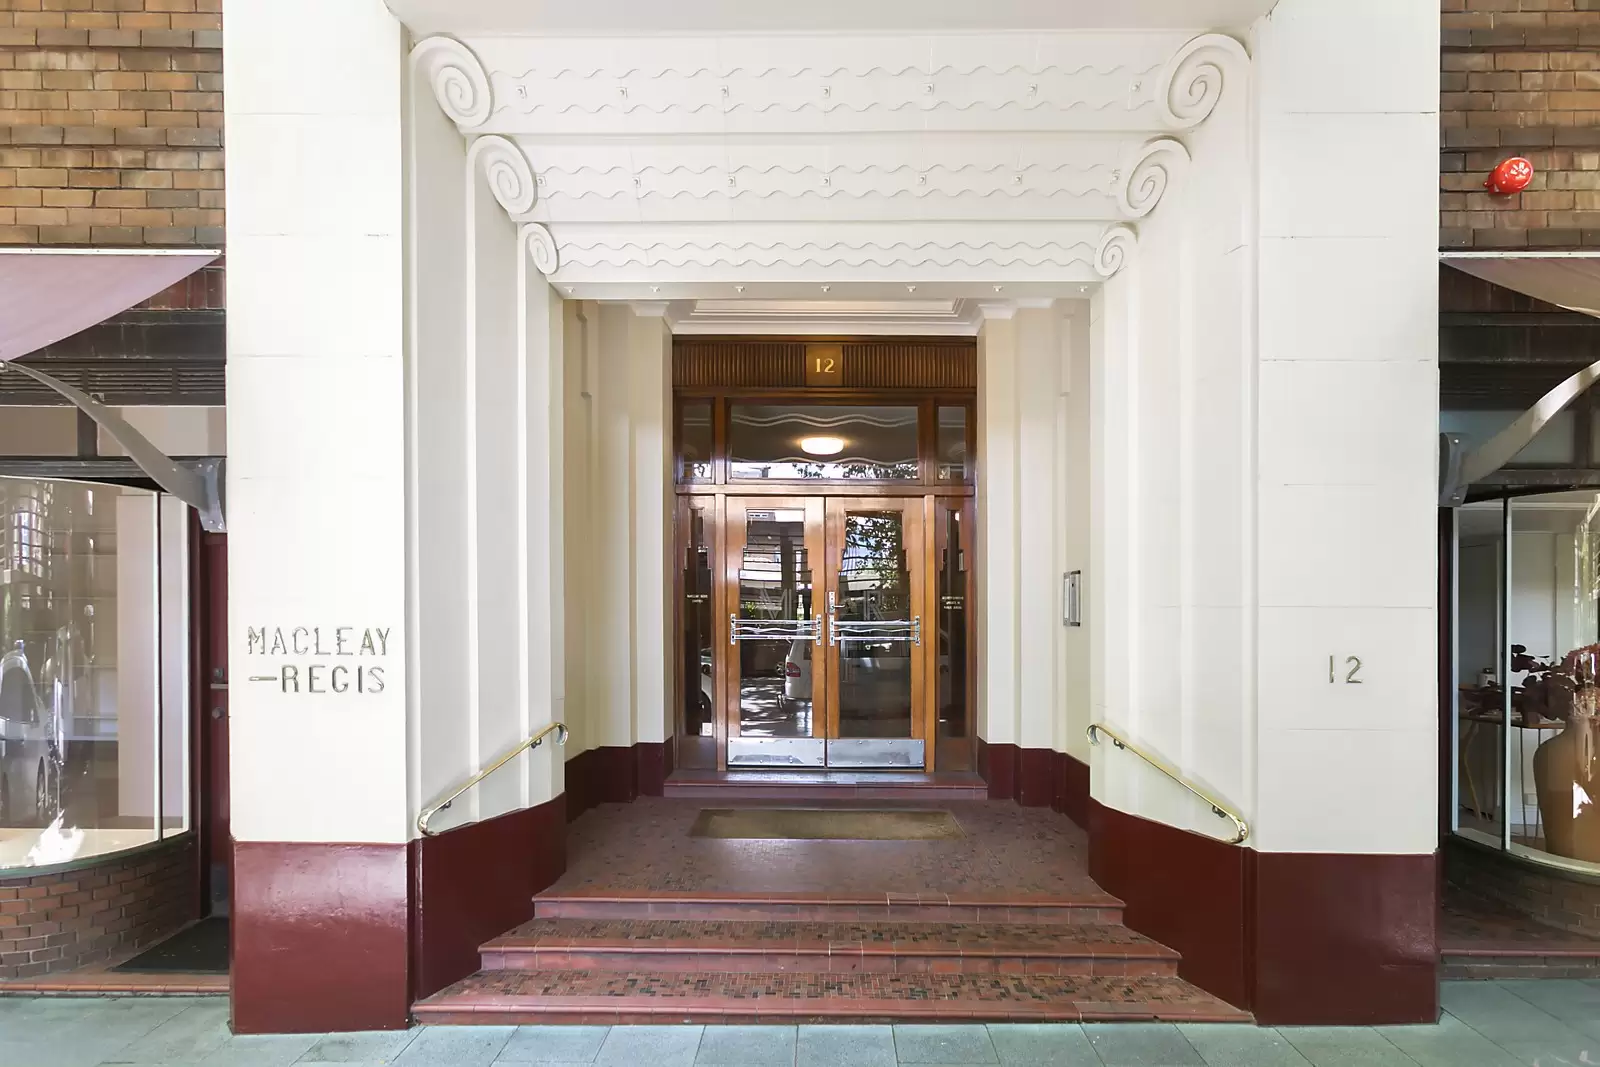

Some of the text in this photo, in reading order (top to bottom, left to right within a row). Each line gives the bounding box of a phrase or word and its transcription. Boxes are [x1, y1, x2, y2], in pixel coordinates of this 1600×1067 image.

[1510, 162, 1530, 175] FIRE
[816, 357, 835, 373] 12
[248, 626, 390, 655] MACLEAY
[1329, 655, 1362, 684] 12
